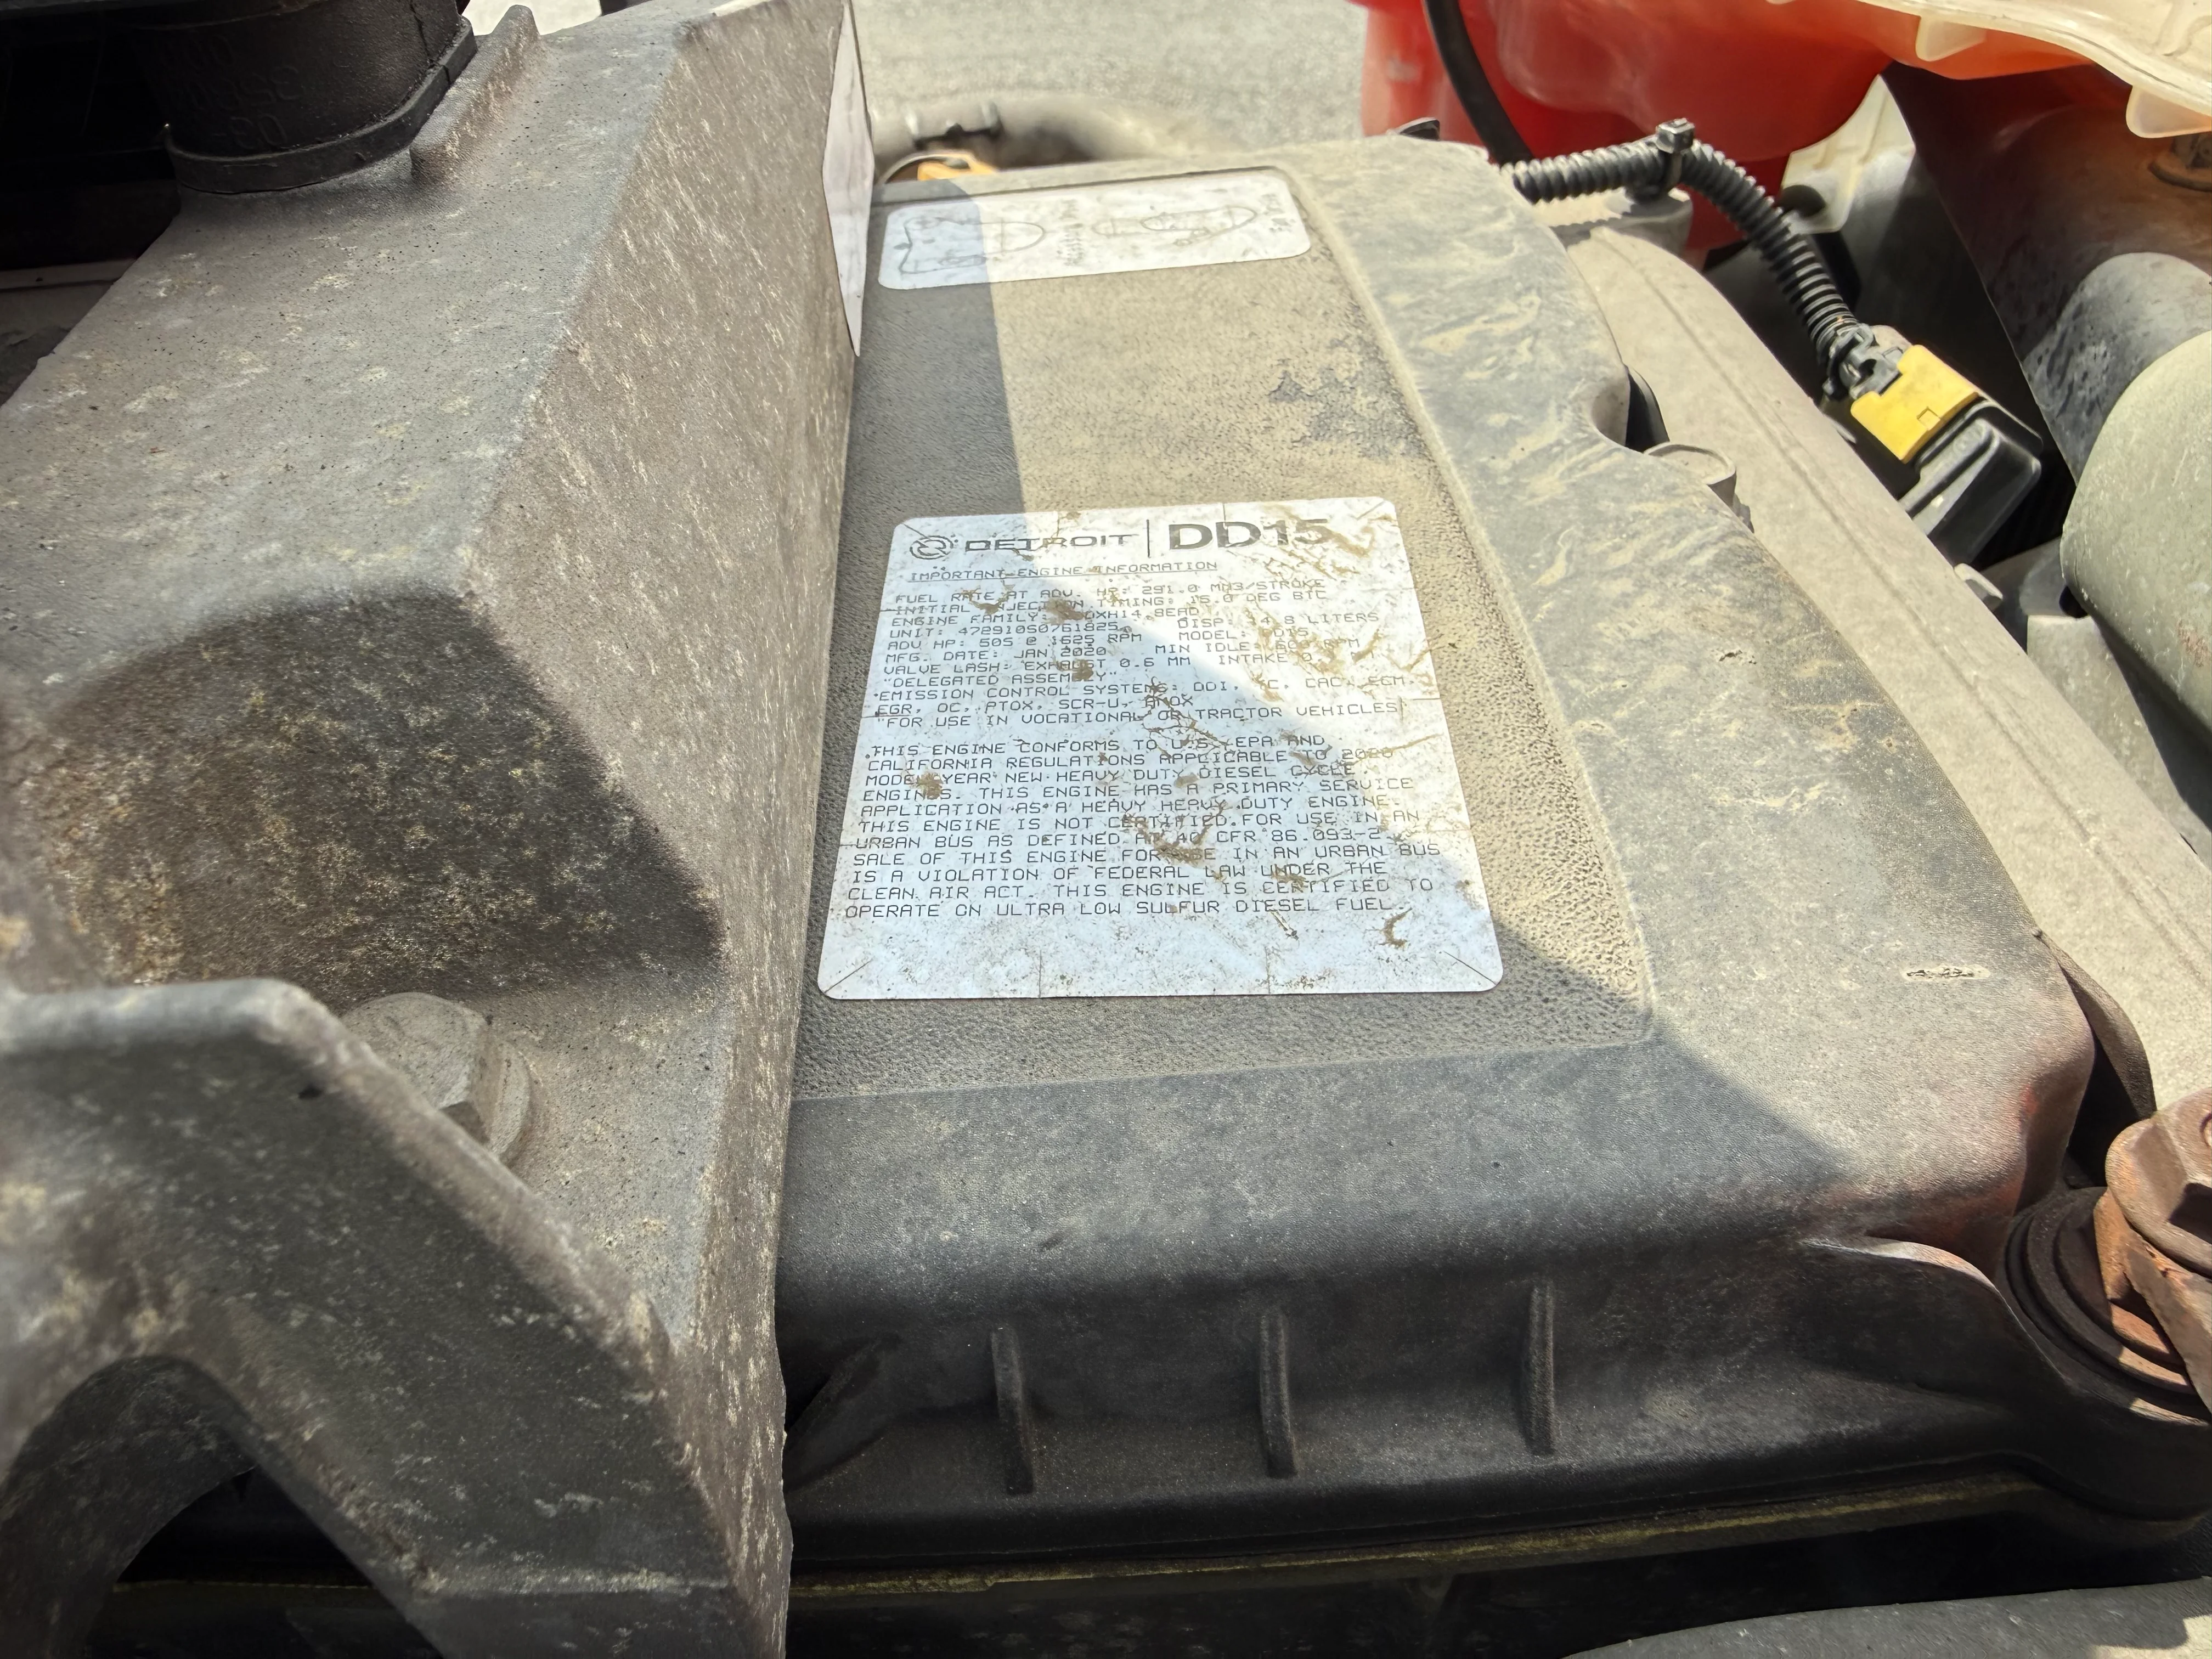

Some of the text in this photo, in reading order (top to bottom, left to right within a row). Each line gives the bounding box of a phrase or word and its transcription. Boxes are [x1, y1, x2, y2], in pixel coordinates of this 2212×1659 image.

[965, 518, 1328, 552] DETROIT DD15
[911, 562, 1217, 581] IMPORTANT ENGINE INFORMATION
[895, 595, 938, 603] FUEL
[951, 591, 995, 601] RATE
[1008, 590, 1028, 600] AT
[1040, 589, 1081, 599] ADV.
[896, 605, 970, 615] INITIAL
[1246, 592, 1281, 602] DEG
[1293, 590, 1327, 600] BTC
[890, 629, 943, 638] UNIT:
[1308, 612, 1380, 624] LITERS
[892, 616, 958, 627] ENGINE
[970, 613, 1047, 624] FAMILY:
[888, 641, 922, 650] ADV
[1026, 637, 1037, 645] @
[1108, 633, 1142, 643] RPM
[944, 650, 998, 661] DATE:
[1014, 649, 1048, 658] JAN
[1060, 647, 1107, 657] 2020
[1155, 644, 1190, 654] MIN
[884, 664, 941, 674] VALVE
[1120, 657, 1155, 668] 0.6
[1168, 656, 1191, 666] MM
[1219, 653, 1289, 665] INTAKE
[879, 689, 974, 701] EMISSION
[987, 686, 1070, 698] CONTROL
[936, 715, 972, 726] USE
[987, 714, 1008, 726] IN
[1021, 713, 1142, 725] VOCATIONAL
[1158, 709, 1180, 721] OR
[1195, 707, 1282, 719] TRACTOR
[1296, 702, 1398, 716] VEHICLES
[871, 745, 918, 757] THIS
[932, 743, 1006, 755] ENGINE
[1019, 740, 1120, 753] CONFORMS
[1133, 740, 1158, 751] TO
[1235, 736, 1273, 748] EPA
[1288, 735, 1325, 747] AND
[868, 758, 992, 771] CALIFORNIA
[1007, 754, 1146, 768] REGULATIONS
[1159, 750, 1288, 765] APPLICABLE
[1302, 749, 1327, 760] TO
[865, 773, 927, 786] MODE
[941, 772, 991, 784] YEAR
[1006, 772, 1042, 783] NEW
[1056, 770, 1120, 782] HEAVY
[1133, 768, 1184, 780] DUTY
[1199, 766, 1276, 780] DIESEL
[862, 777, 1414, 802] ENGINS. THIS ENGINE HAS A PRIMARY SERVICE
[860, 803, 1002, 817] APPLICATION
[1015, 802, 1041, 814] AS
[1055, 801, 1068, 814] A
[1082, 799, 1146, 813] HEAVY
[1161, 797, 1227, 811] HEAVY
[1241, 797, 1293, 809] DUTY
[858, 810, 1420, 833] THIS ENGINE IS NOT CERTIFIED FOR USE IN AN
[855, 837, 921, 849] URBAN
[934, 835, 973, 848] BUS
[988, 834, 1013, 847] AS
[1028, 833, 1120, 847] DEFINED
[1216, 831, 1256, 843] CFR
[853, 853, 906, 866] SALE
[920, 852, 946, 865] OF
[961, 851, 1012, 864] THIS
[1026, 849, 1107, 864] ENGINE
[1122, 849, 1161, 862] FOR
[1233, 847, 1258, 860] IN
[1273, 847, 1300, 859] AN
[1314, 845, 1384, 858] URBAN
[1400, 843, 1441, 856] BUS
[853, 861, 1388, 883] IS A VIOLATION OF FEDERAL LAW UNDER THE
[848, 887, 915, 900] CLEAN
[929, 886, 969, 900] AIR
[1053, 884, 1107, 898] THIS
[1122, 882, 1205, 896] ENGINE
[1222, 882, 1248, 895] IS
[1262, 878, 1390, 894] CERTIFIED
[1404, 878, 1434, 891] TO
[845, 904, 940, 918] OPERATE
[955, 904, 982, 918] ON
[996, 902, 1065, 916] ULTRA
[1080, 901, 1121, 915] LOW
[1136, 900, 1221, 915] SULFUR
[1235, 898, 1321, 913] DIESEL
